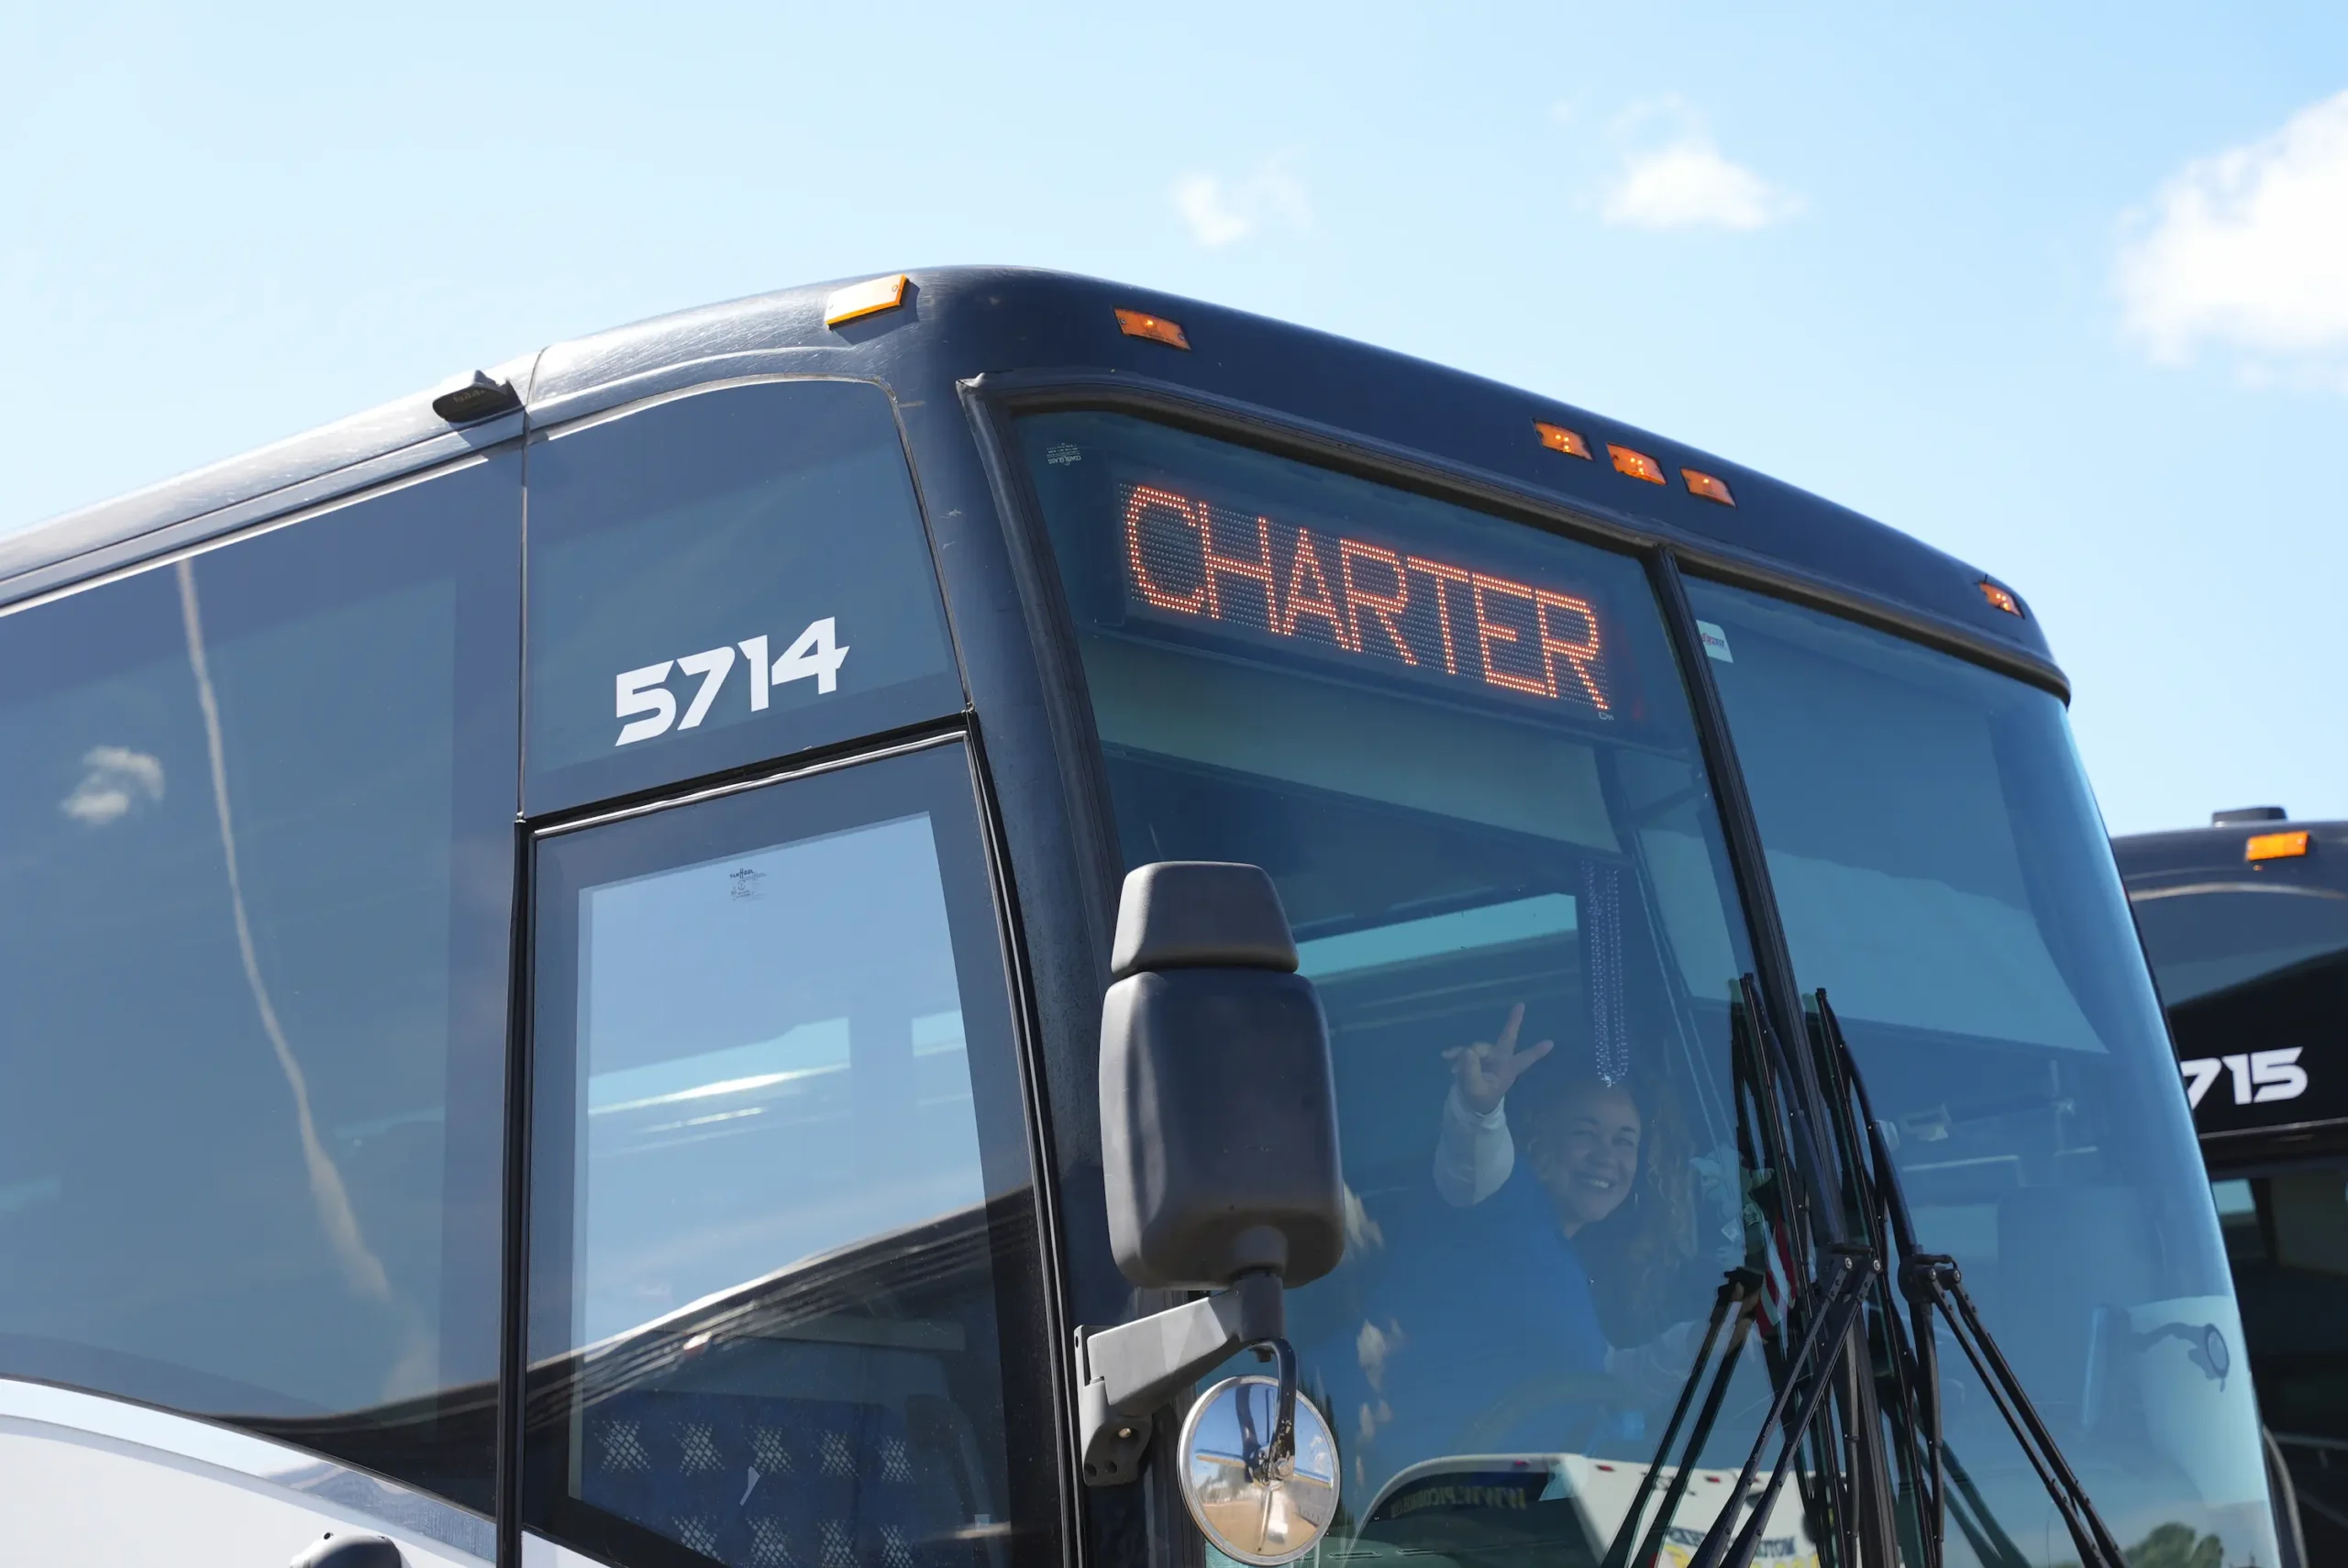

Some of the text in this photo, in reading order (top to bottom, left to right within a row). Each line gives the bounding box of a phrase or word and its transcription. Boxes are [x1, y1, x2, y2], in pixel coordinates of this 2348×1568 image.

[1124, 485, 1611, 710] CHARTER
[615, 616, 850, 747] 5714
[2180, 1046, 2309, 1111] 715
